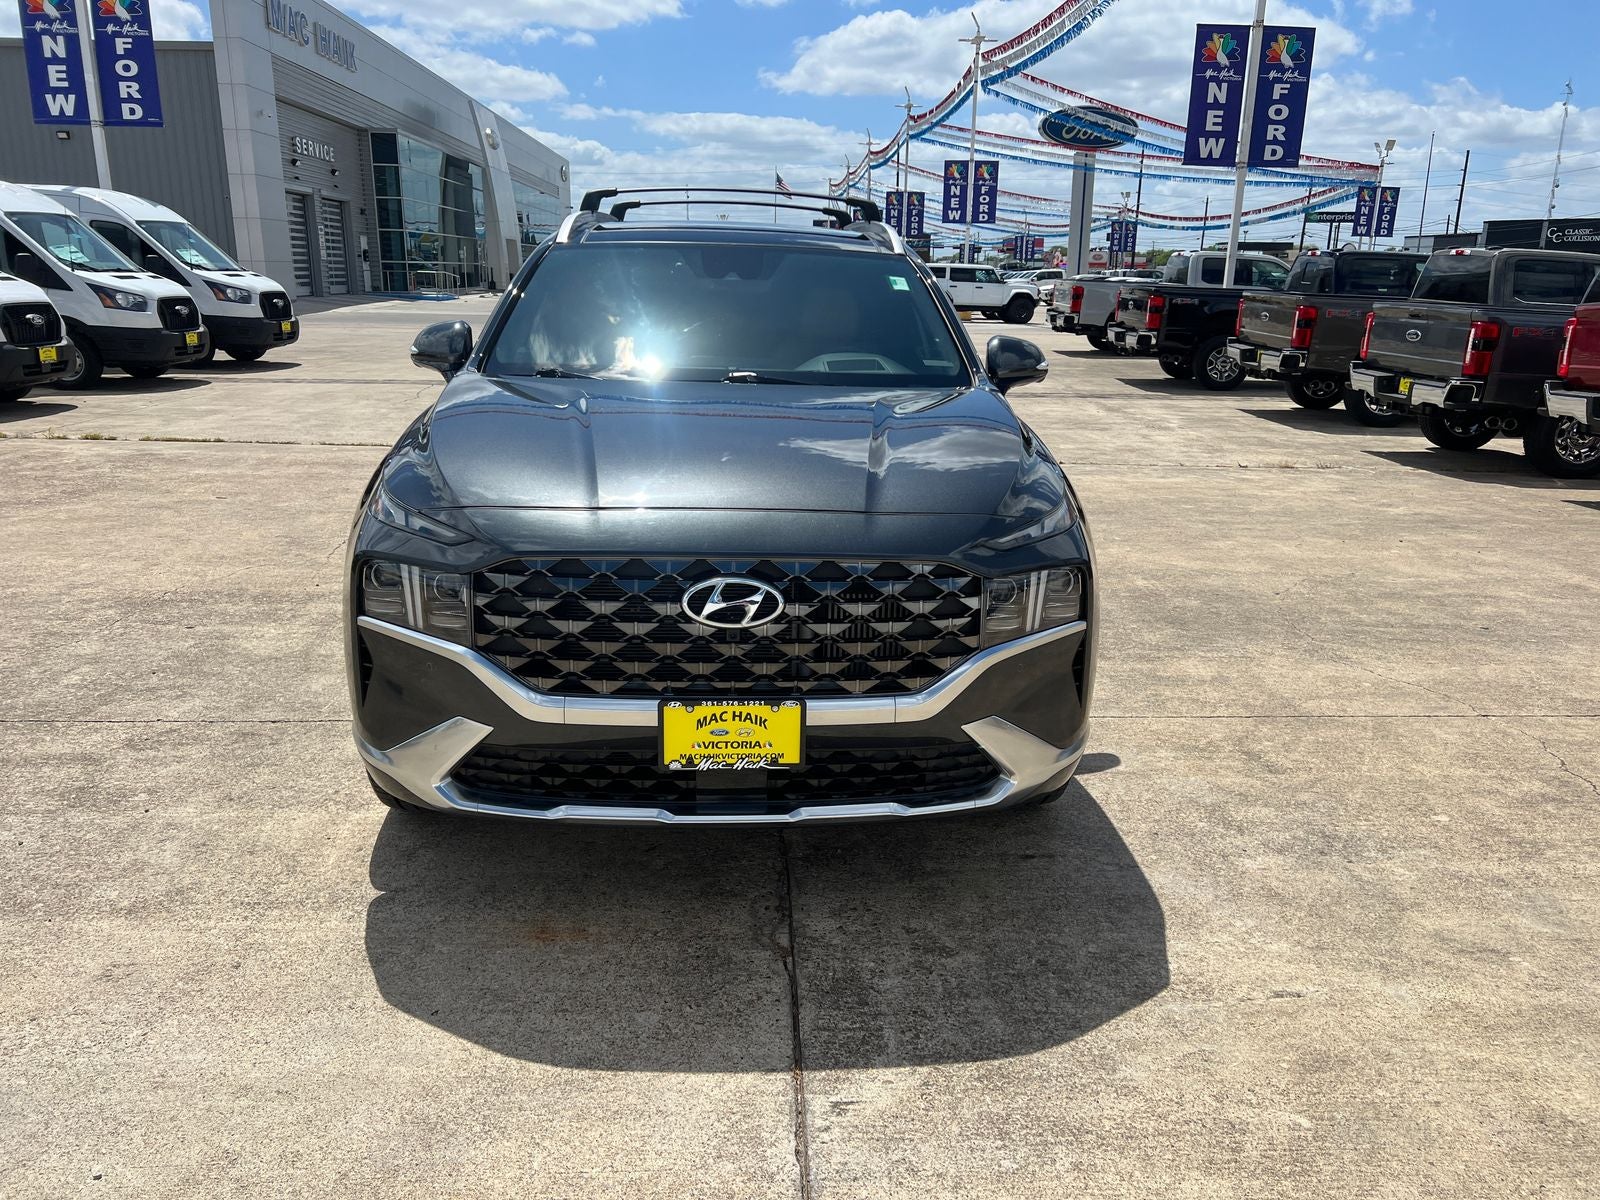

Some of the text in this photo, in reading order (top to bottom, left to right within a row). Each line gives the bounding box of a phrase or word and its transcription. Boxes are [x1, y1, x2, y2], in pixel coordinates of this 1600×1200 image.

[267, 0, 358, 73] MAC HAIK
[41, 34, 76, 117] NEW
[114, 37, 144, 121] FORD
[1198, 81, 1228, 159] NEW
[1263, 83, 1291, 161] FORD
[292, 136, 335, 162] SERVICE
[948, 185, 961, 221] NEW
[978, 185, 990, 222] FORD
[911, 209, 919, 236] FORD
[1357, 206, 1369, 235] NEW
[1380, 206, 1391, 235] FORD
[696, 710, 768, 731] MAC HAIK
[680, 752, 785, 760] MACHAIKVICTORIACOM
[702, 740, 762, 750] VICTORIA
